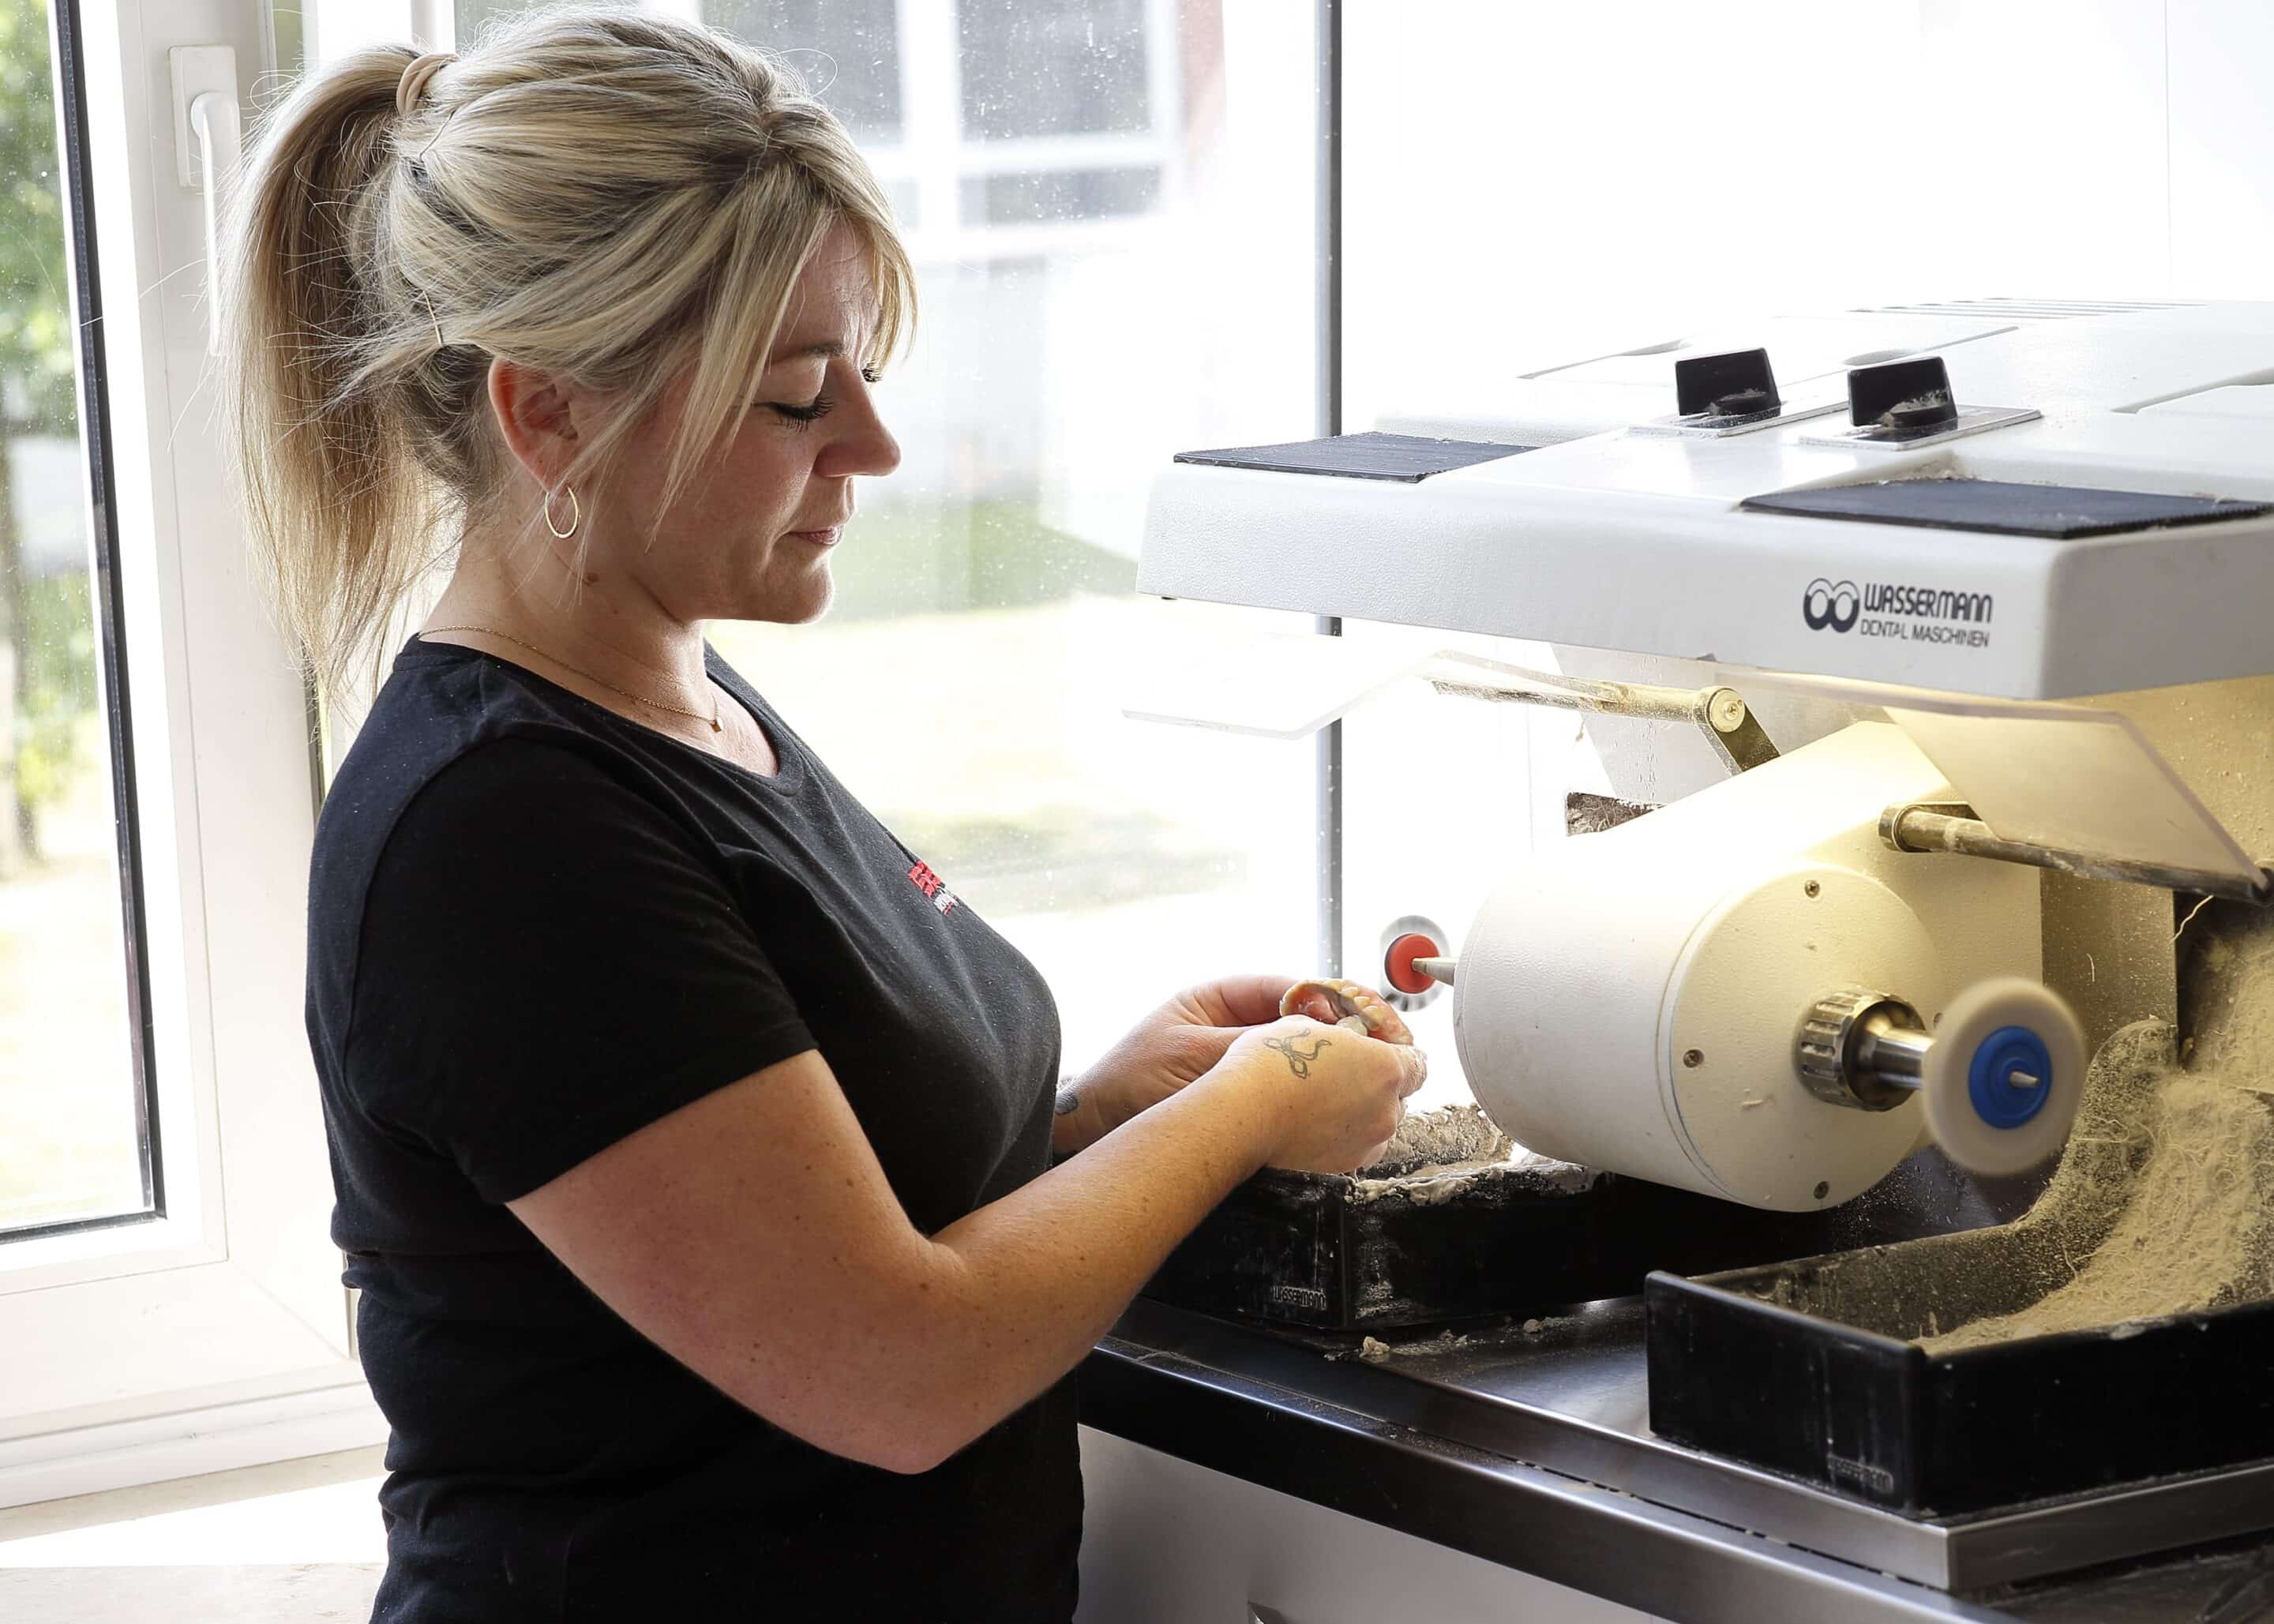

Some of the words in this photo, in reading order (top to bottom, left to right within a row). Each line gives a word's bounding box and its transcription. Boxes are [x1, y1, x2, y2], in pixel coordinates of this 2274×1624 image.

[1863, 582, 1994, 624] WASSERMANN
[1859, 617, 1909, 640] DENTAL
[1911, 623, 1991, 648] MASCHINEN
